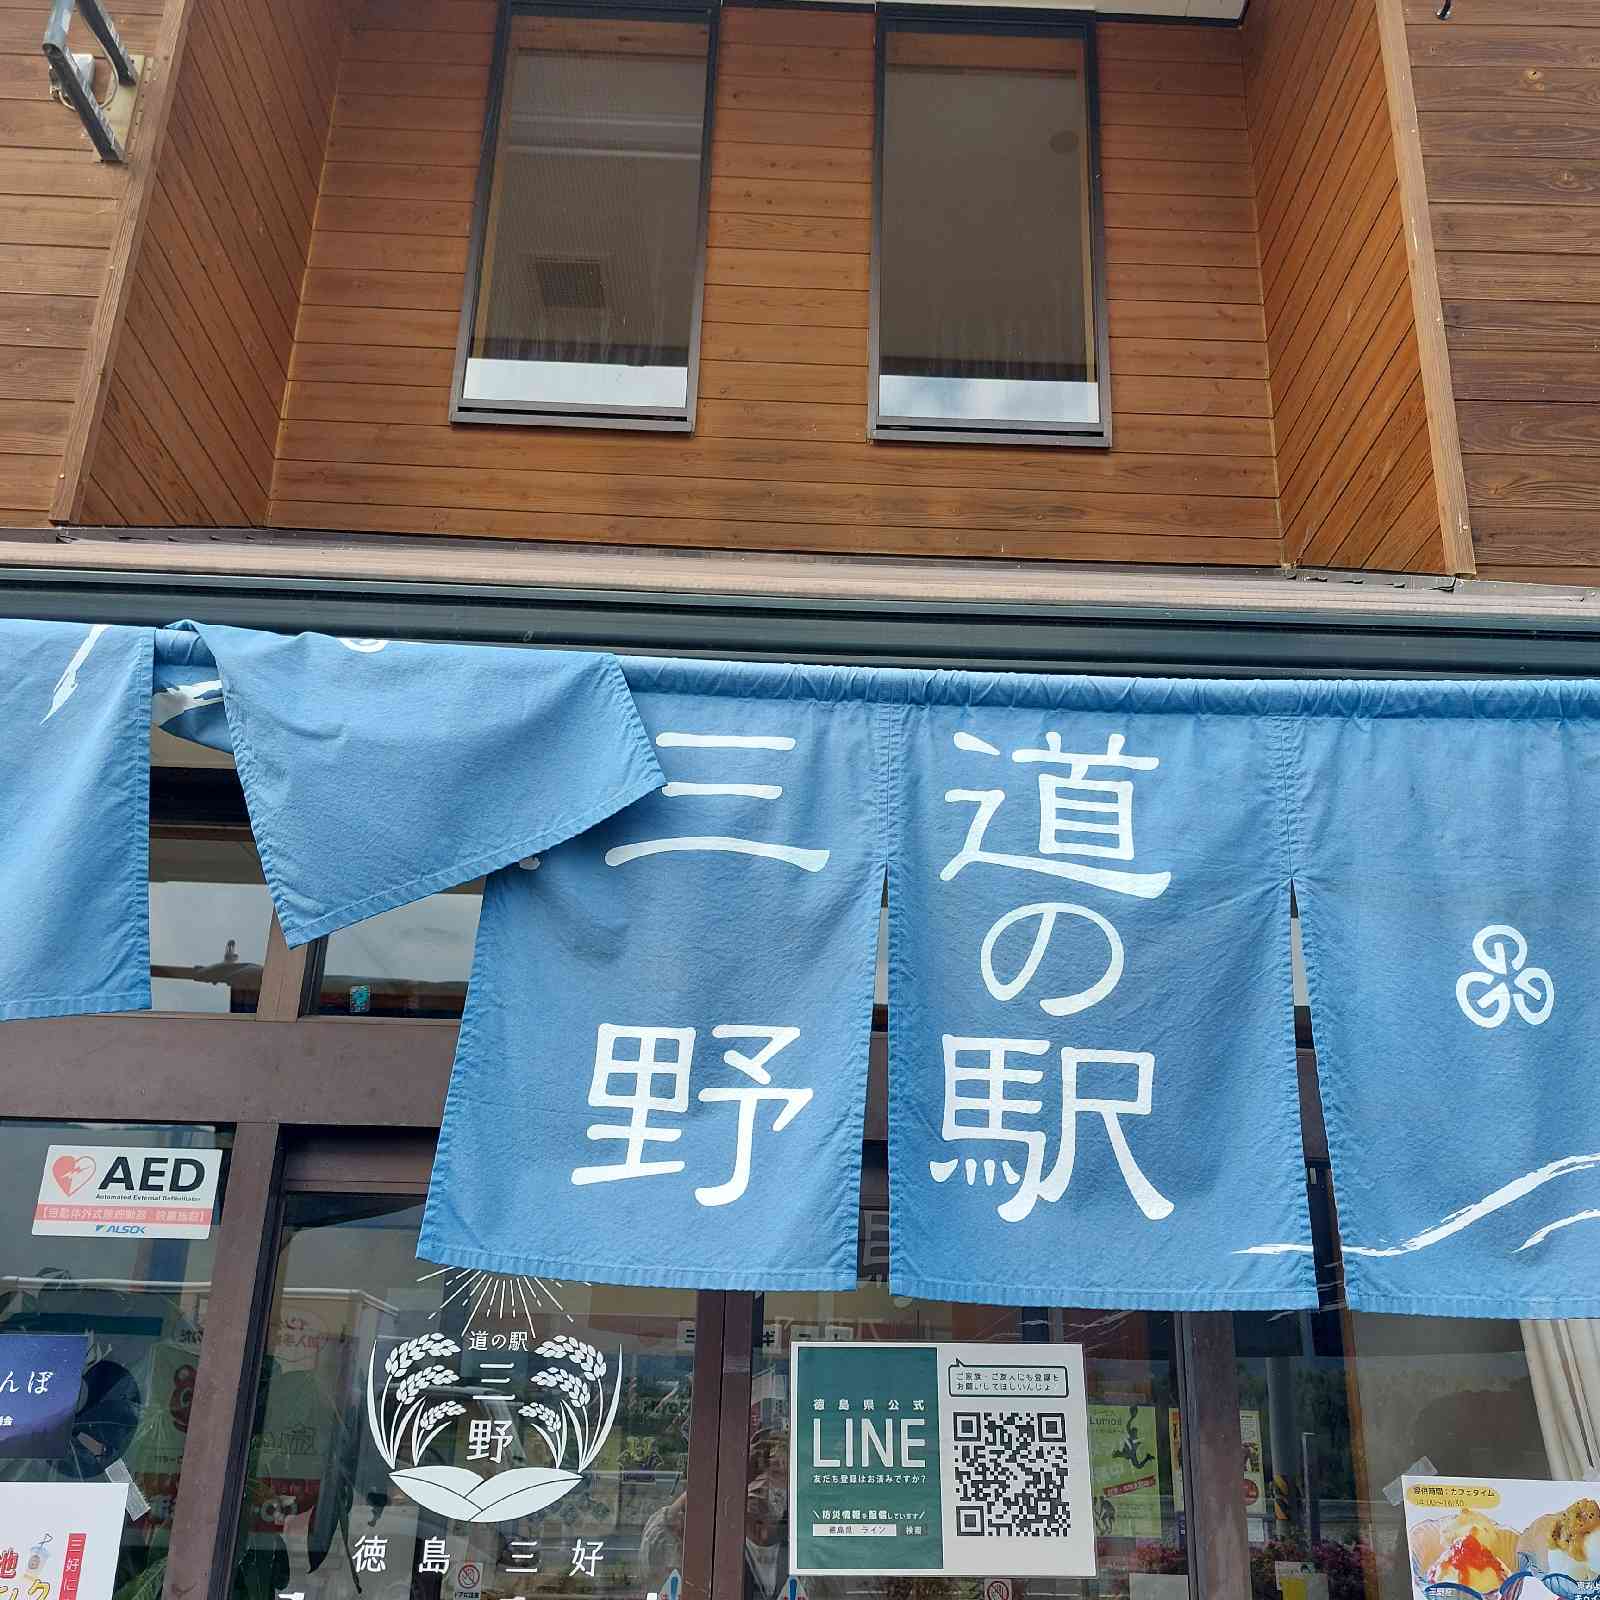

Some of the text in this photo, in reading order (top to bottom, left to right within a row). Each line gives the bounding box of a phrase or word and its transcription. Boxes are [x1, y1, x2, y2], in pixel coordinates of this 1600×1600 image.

[570, 731, 831, 1208] 三野
[929, 731, 1175, 1223] 道の駅
[98, 1156, 206, 1193] AED
[468, 1330, 530, 1353] 道の駅
[466, 1361, 516, 1464] 三野
[812, 1417, 927, 1468] LINE
[352, 1535, 605, 1578] 徳島 三好
